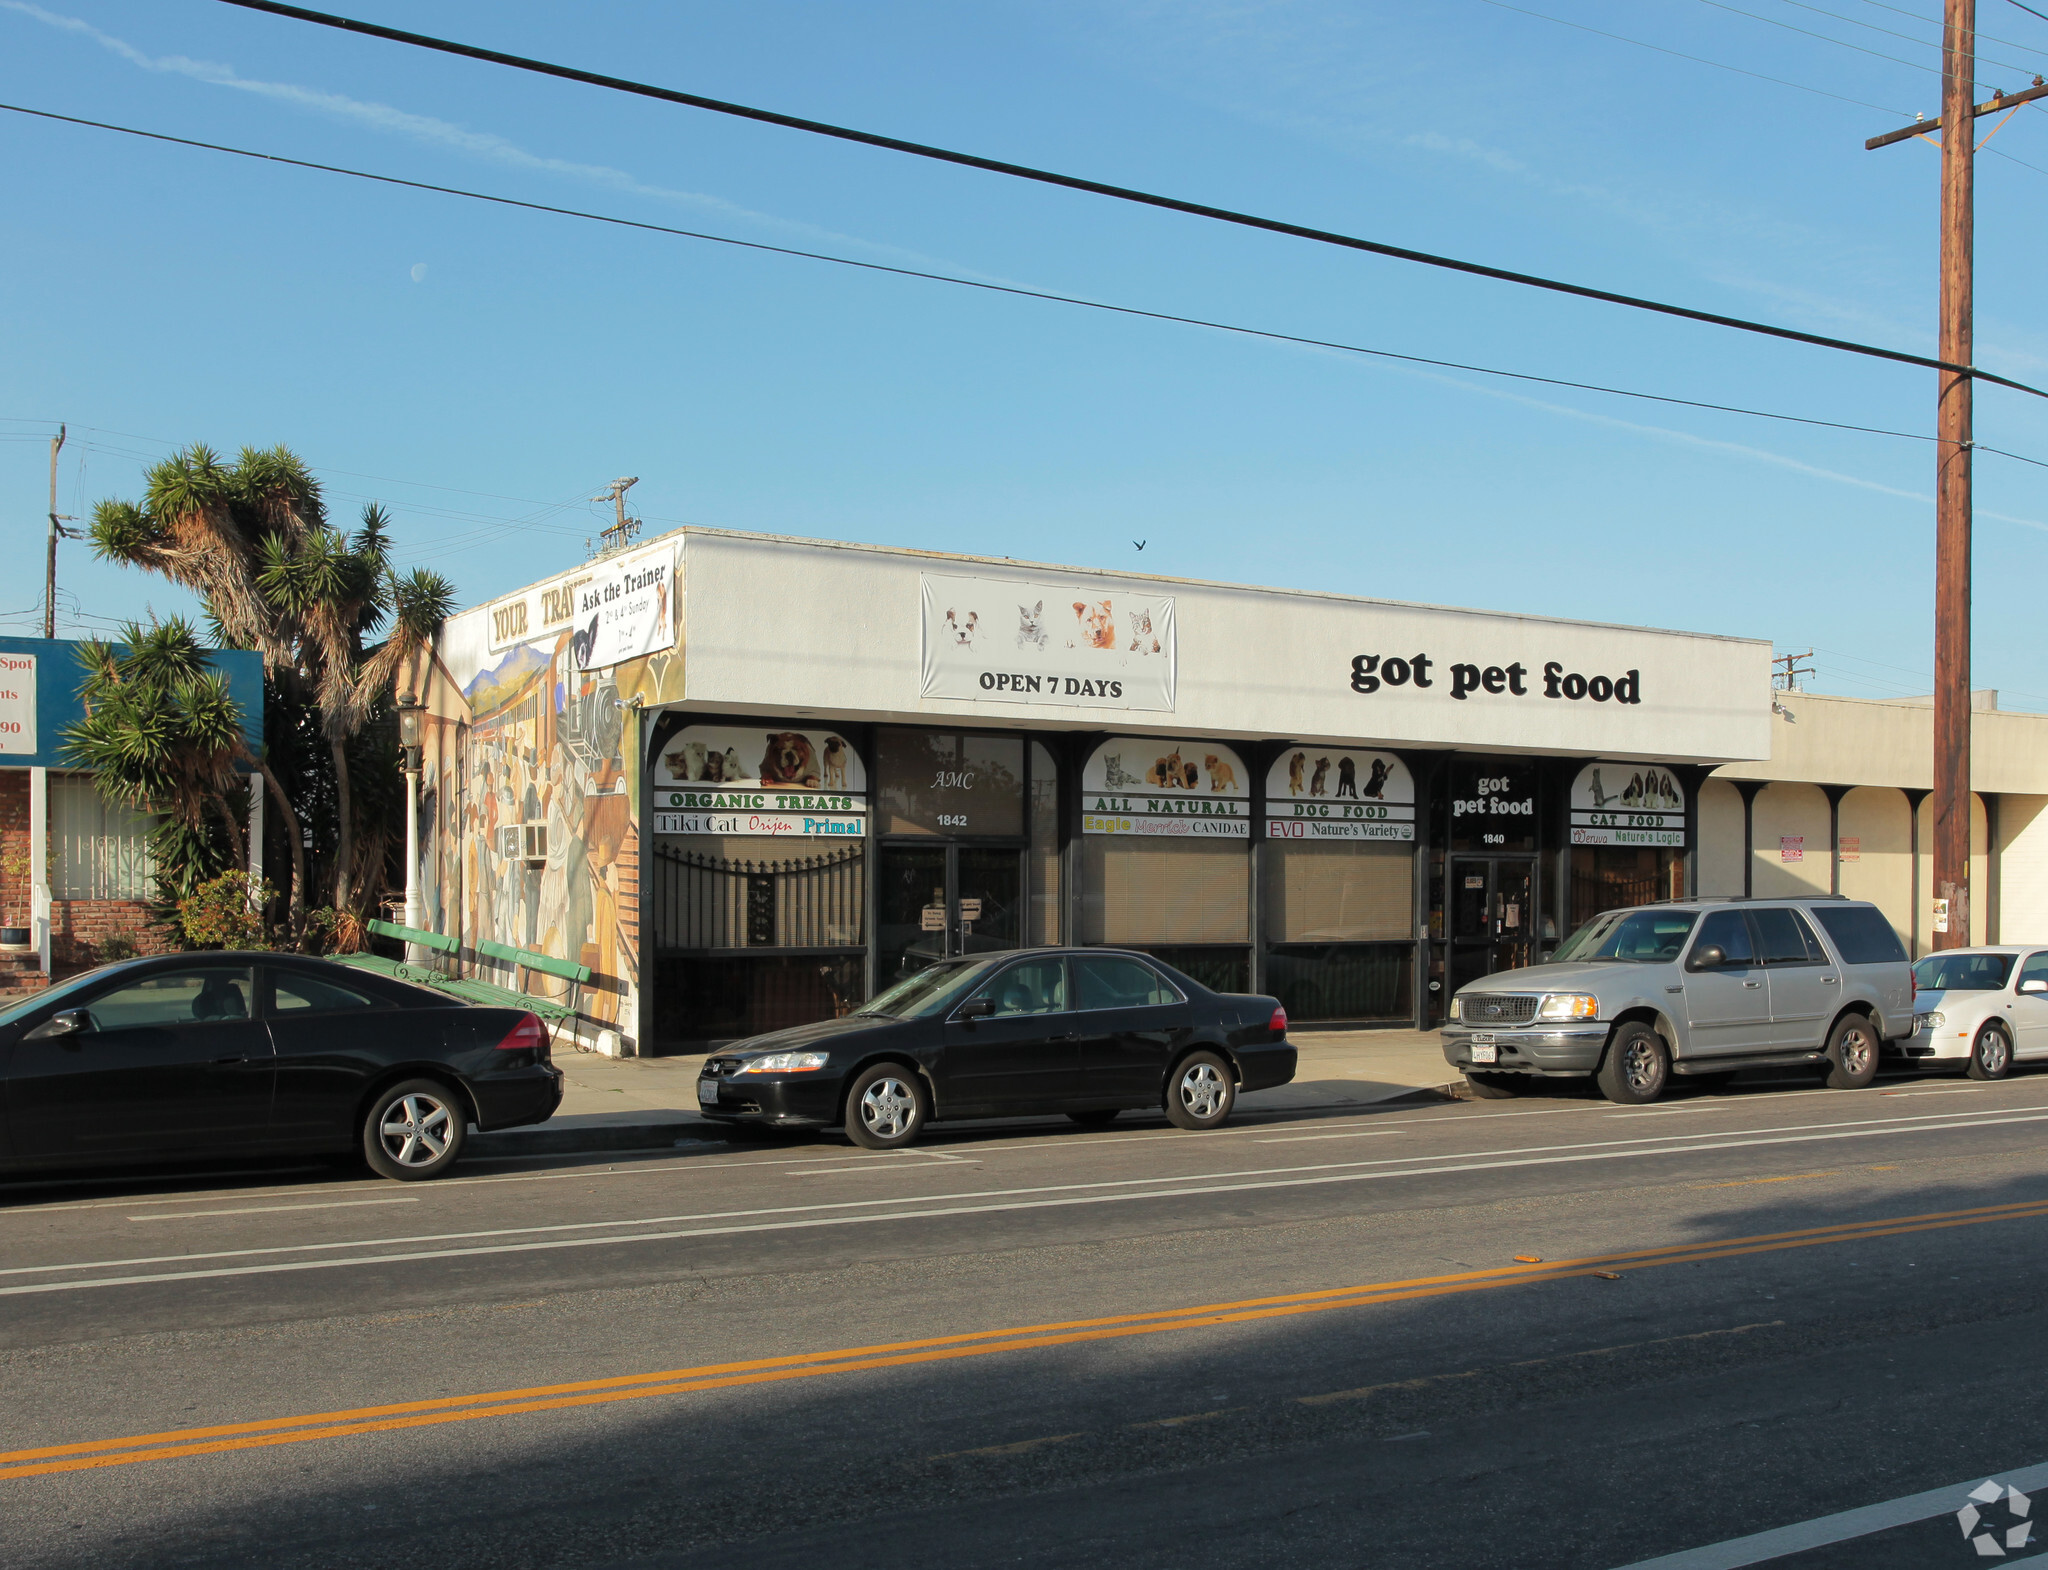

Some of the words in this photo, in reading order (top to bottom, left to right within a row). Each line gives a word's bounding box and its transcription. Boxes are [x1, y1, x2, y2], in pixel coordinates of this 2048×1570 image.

[582, 588, 601, 613] Ask
[604, 582, 620, 602] the
[624, 564, 666, 595] Trainer
[628, 596, 650, 616] Sunday
[493, 601, 528, 641] YOUR
[0, 657, 33, 671] Spot
[979, 672, 1042, 692] OPEN
[1046, 677, 1059, 694] 7
[1064, 678, 1122, 698] DAYS
[1350, 653, 1433, 694] got
[1450, 662, 1528, 700] pet
[1543, 661, 1641, 705] food
[930, 770, 975, 790] AMC
[1478, 776, 1510, 796] got
[669, 793, 765, 808] ORGANIC
[775, 795, 853, 810] TREATS
[1095, 797, 1132, 811] ALL
[1147, 799, 1238, 814] NATURAL
[1293, 804, 1330, 816] DOG
[1343, 805, 1388, 818] FOOD
[1453, 797, 1486, 817] pet
[1490, 796, 1533, 815] food
[656, 814, 699, 832] Tiki
[703, 815, 739, 832] Cat
[749, 815, 793, 836] Orijen
[803, 817, 862, 835] Primal
[936, 814, 968, 827] 1842
[1084, 816, 1131, 832] Eagle
[1134, 818, 1190, 835] Merrick
[1192, 821, 1247, 835] CANIDAE
[1270, 821, 1304, 838] EVO
[1311, 822, 1359, 837] Nature's
[1361, 823, 1400, 839] Variety
[1590, 814, 1618, 825] CAT
[1627, 815, 1664, 827] FOOD
[1483, 833, 1505, 844] 1840
[1573, 828, 1608, 844] Weruva
[1615, 830, 1653, 843] Nature's
[1656, 832, 1681, 845] Logic
